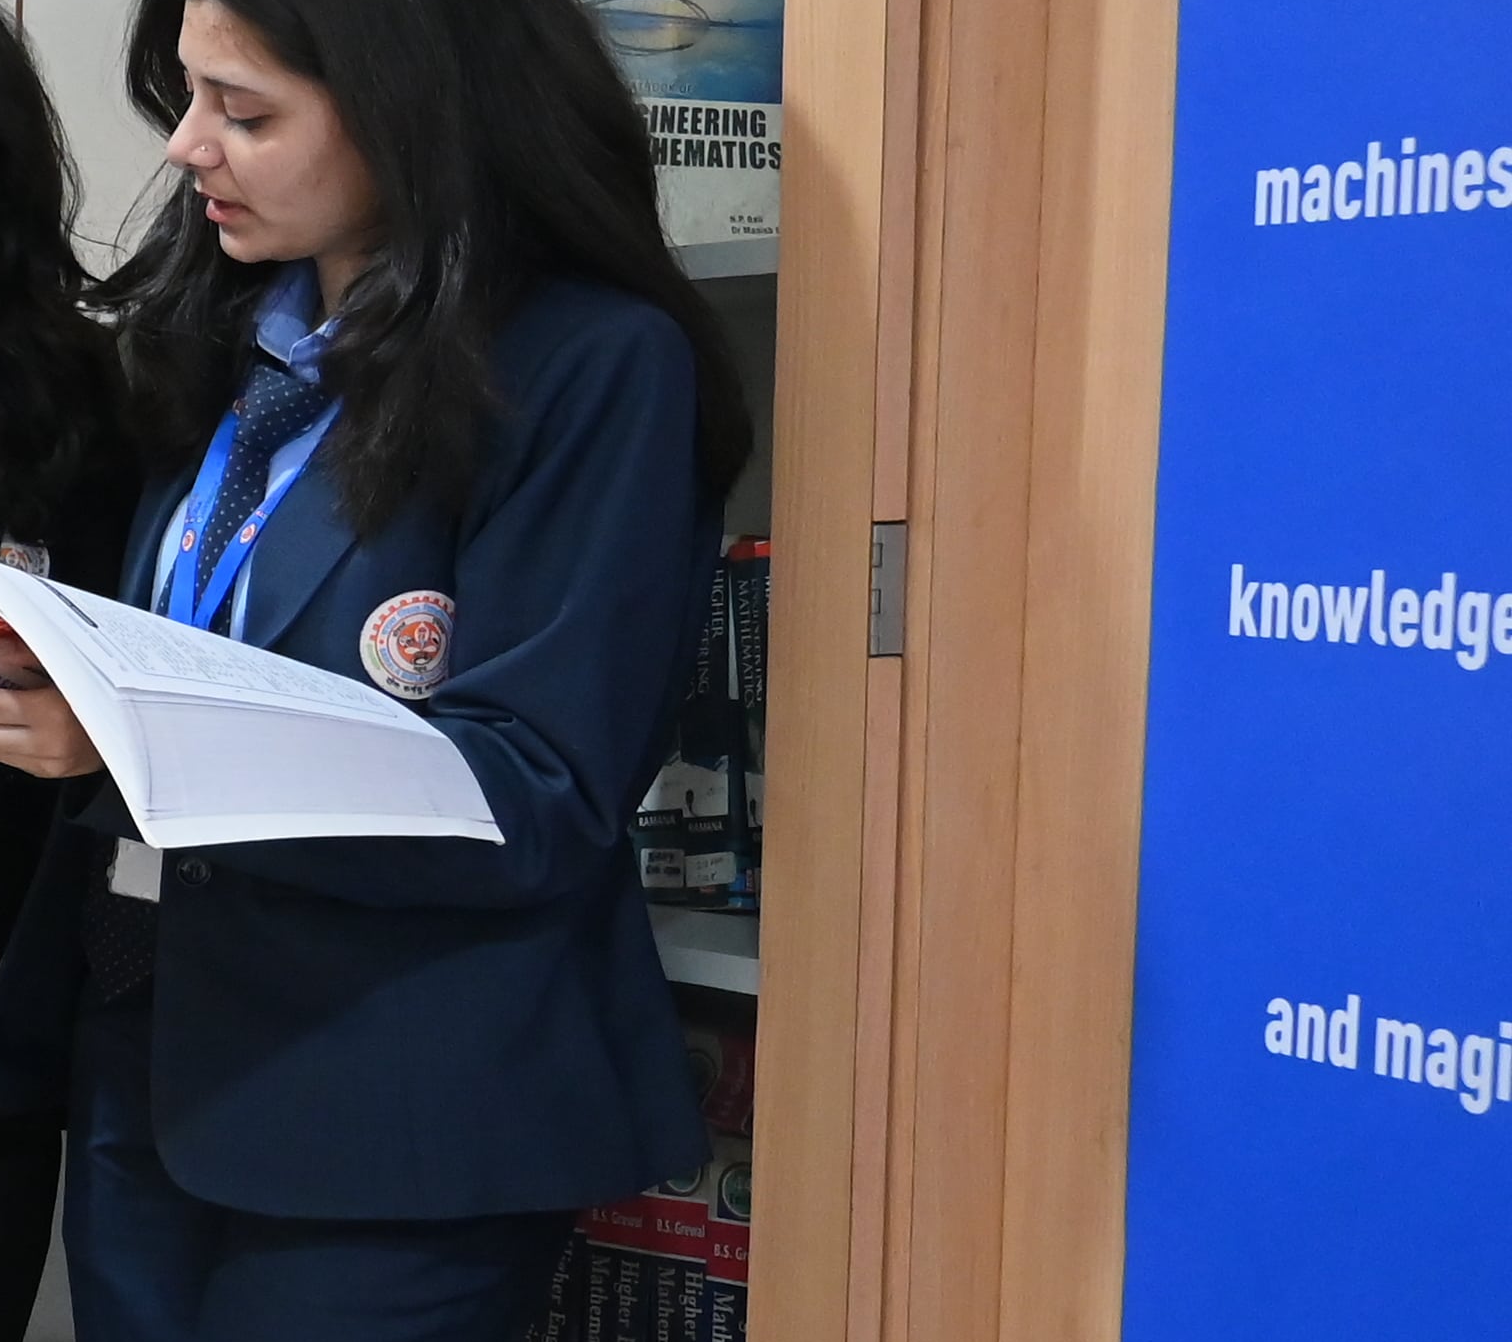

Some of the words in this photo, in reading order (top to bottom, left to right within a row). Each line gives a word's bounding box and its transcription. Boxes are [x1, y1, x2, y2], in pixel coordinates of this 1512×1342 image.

[646, 105, 767, 139] INEERING
[651, 138, 782, 171] HEMATICS
[1253, 136, 1512, 227] machines
[711, 569, 725, 639] HIGHER
[1227, 562, 1512, 671] knowledge
[1264, 993, 1360, 1070] and
[656, 1218, 674, 1234] B.S.
[674, 1221, 706, 1238] Grewal
[713, 1243, 733, 1259] B.S.
[613, 1259, 640, 1330] Higher
[677, 1270, 704, 1342] Higher
